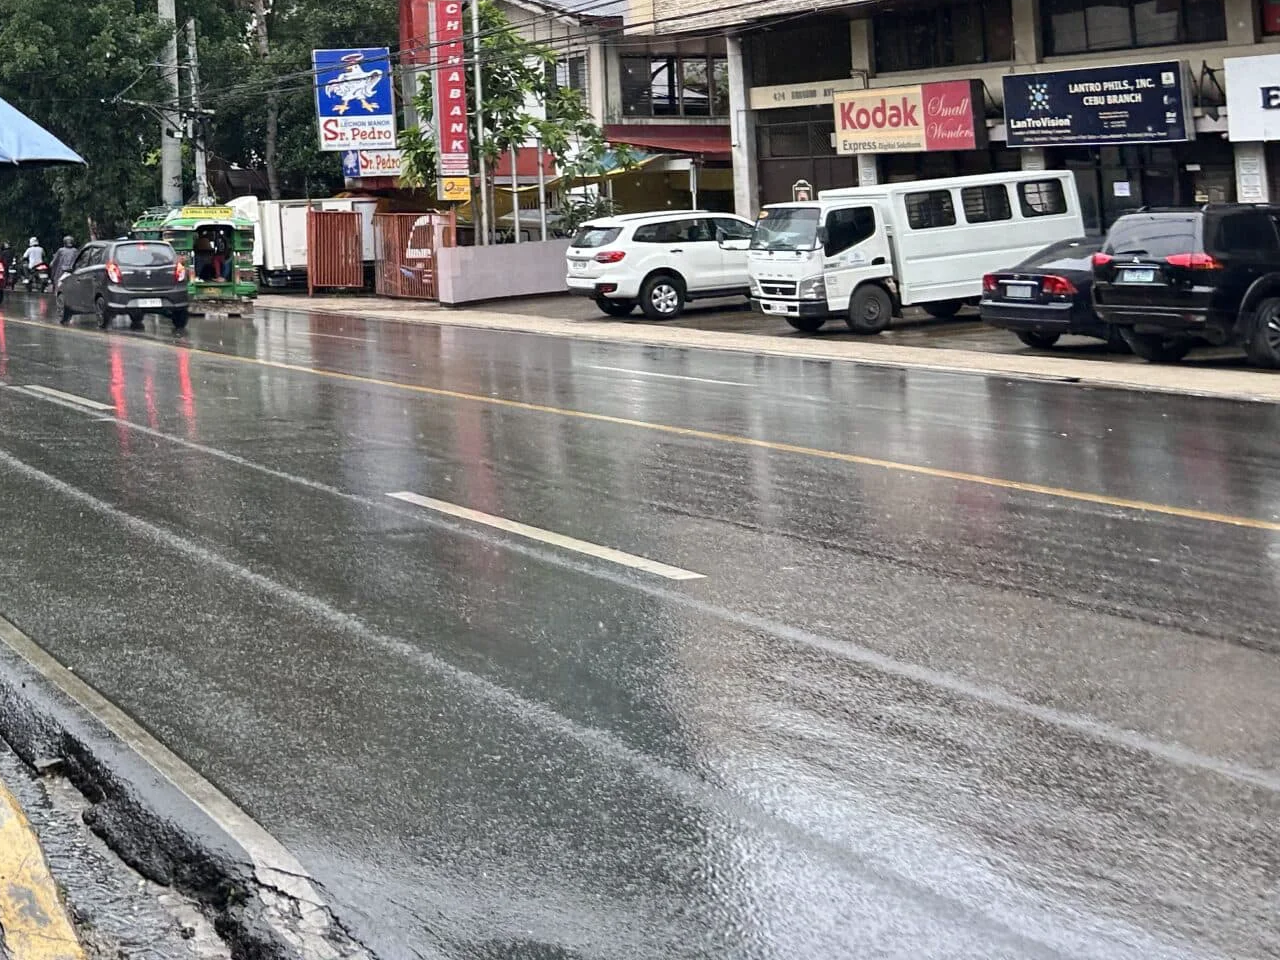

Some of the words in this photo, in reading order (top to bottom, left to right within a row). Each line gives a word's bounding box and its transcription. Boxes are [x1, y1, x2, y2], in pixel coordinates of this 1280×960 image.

[1068, 82, 1101, 94] LANTRO
[1135, 77, 1156, 89] INC.
[927, 94, 969, 117] Small
[1083, 95, 1105, 106] CEBU
[1106, 93, 1142, 105] BRANCH
[839, 96, 919, 130] Kodak
[323, 118, 349, 142] Sr.
[351, 126, 392, 141] Pedro
[842, 139, 877, 153] Express
[878, 142, 896, 151] Digital
[360, 150, 375, 169] Sr.
[375, 153, 400, 170] Pedro
